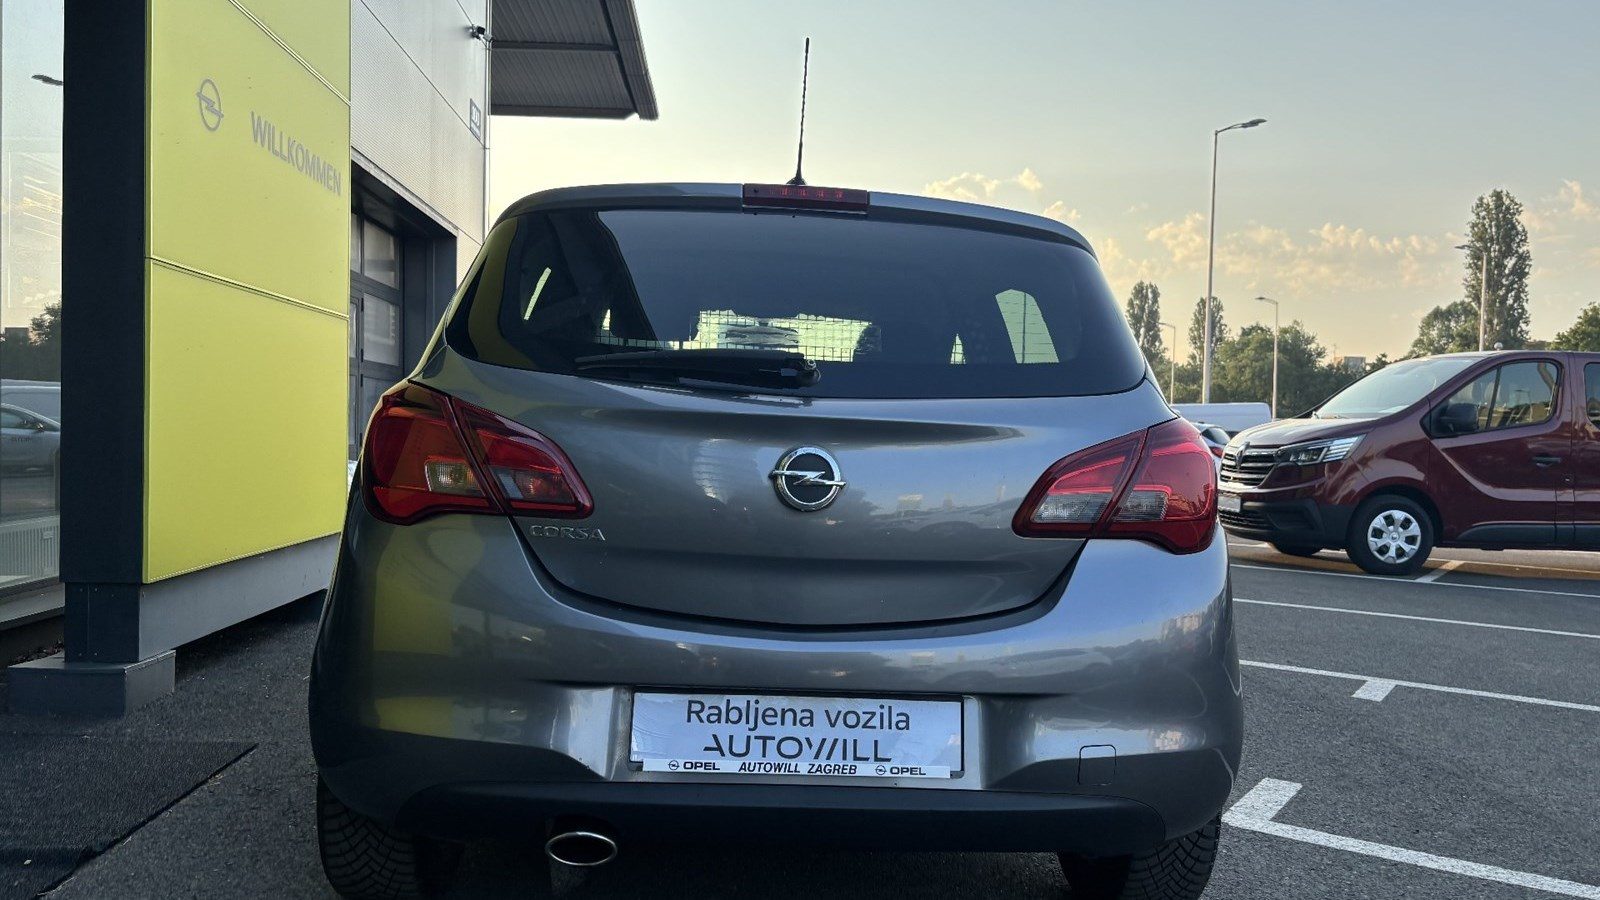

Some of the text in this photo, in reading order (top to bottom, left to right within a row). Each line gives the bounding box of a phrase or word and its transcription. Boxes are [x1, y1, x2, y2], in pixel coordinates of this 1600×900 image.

[251, 110, 341, 197] WILLKOMMEN
[530, 525, 606, 541] CORSA
[686, 699, 910, 731] Rabljena vozila
[703, 733, 892, 762] AUTOWILL
[683, 761, 926, 776] OPEL AUTOWILL ZAGREB OPEL
